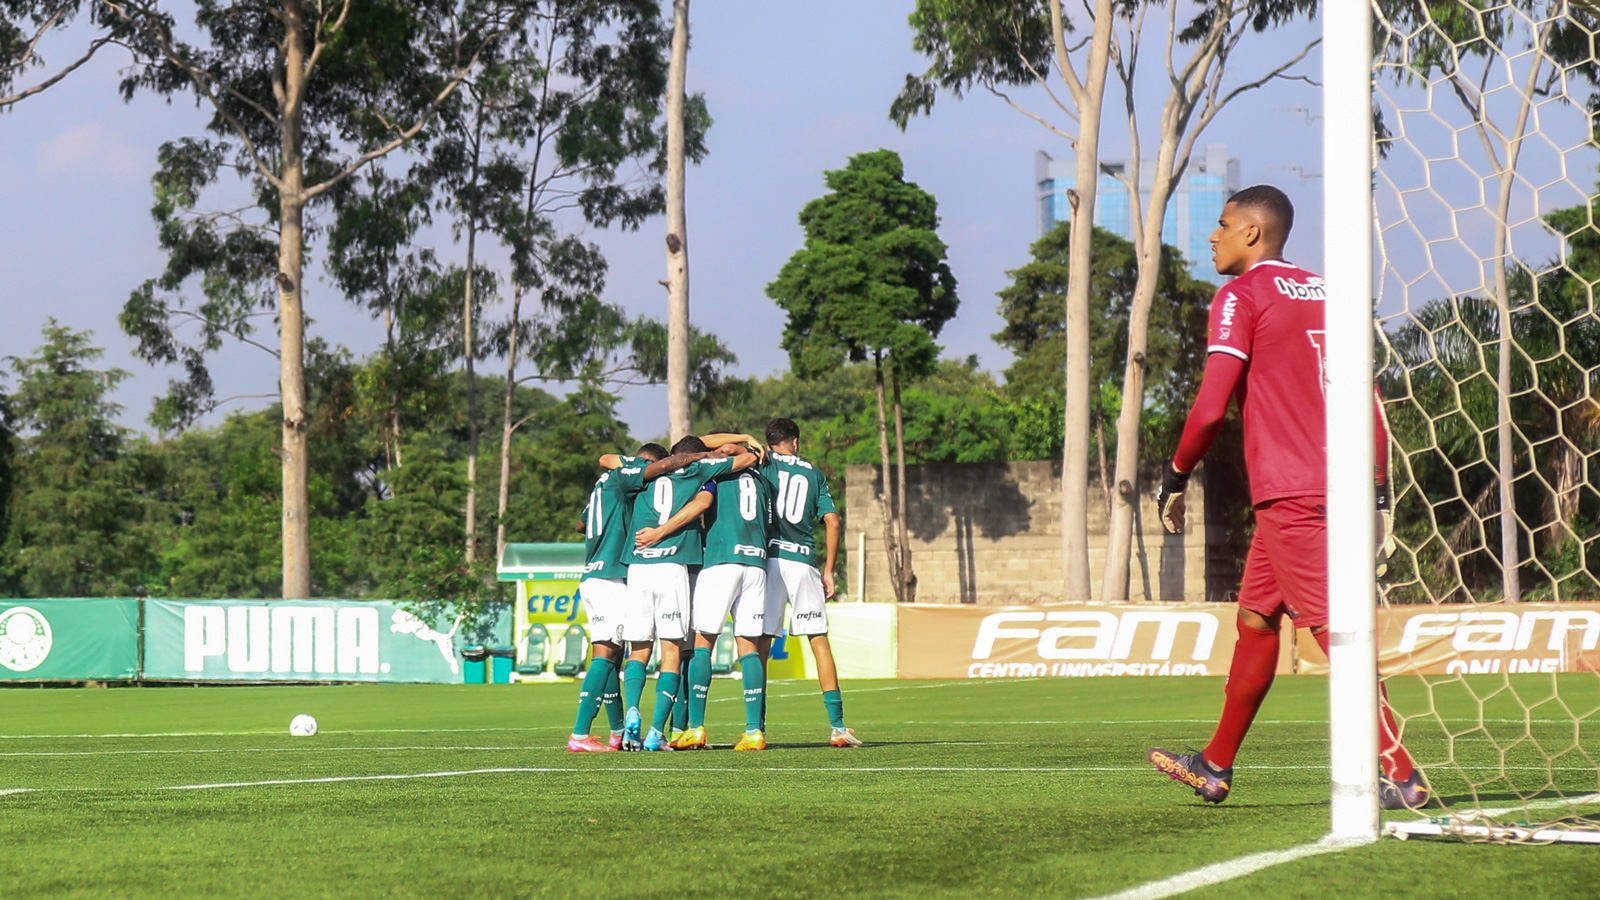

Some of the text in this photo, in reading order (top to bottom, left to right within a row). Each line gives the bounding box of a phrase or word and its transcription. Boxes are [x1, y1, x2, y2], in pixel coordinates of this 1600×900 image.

[1220, 292, 1238, 325] MRV
[587, 487, 603, 539] 11
[653, 475, 674, 525] 9
[738, 473, 758, 521] 8
[776, 470, 809, 524] 10
[582, 560, 605, 573] am
[528, 587, 581, 621] cref
[796, 610, 822, 621] crefisa
[967, 660, 1207, 678] CENTRO UNIVERSITÁRIO
[1445, 658, 1560, 674] ONLINE
